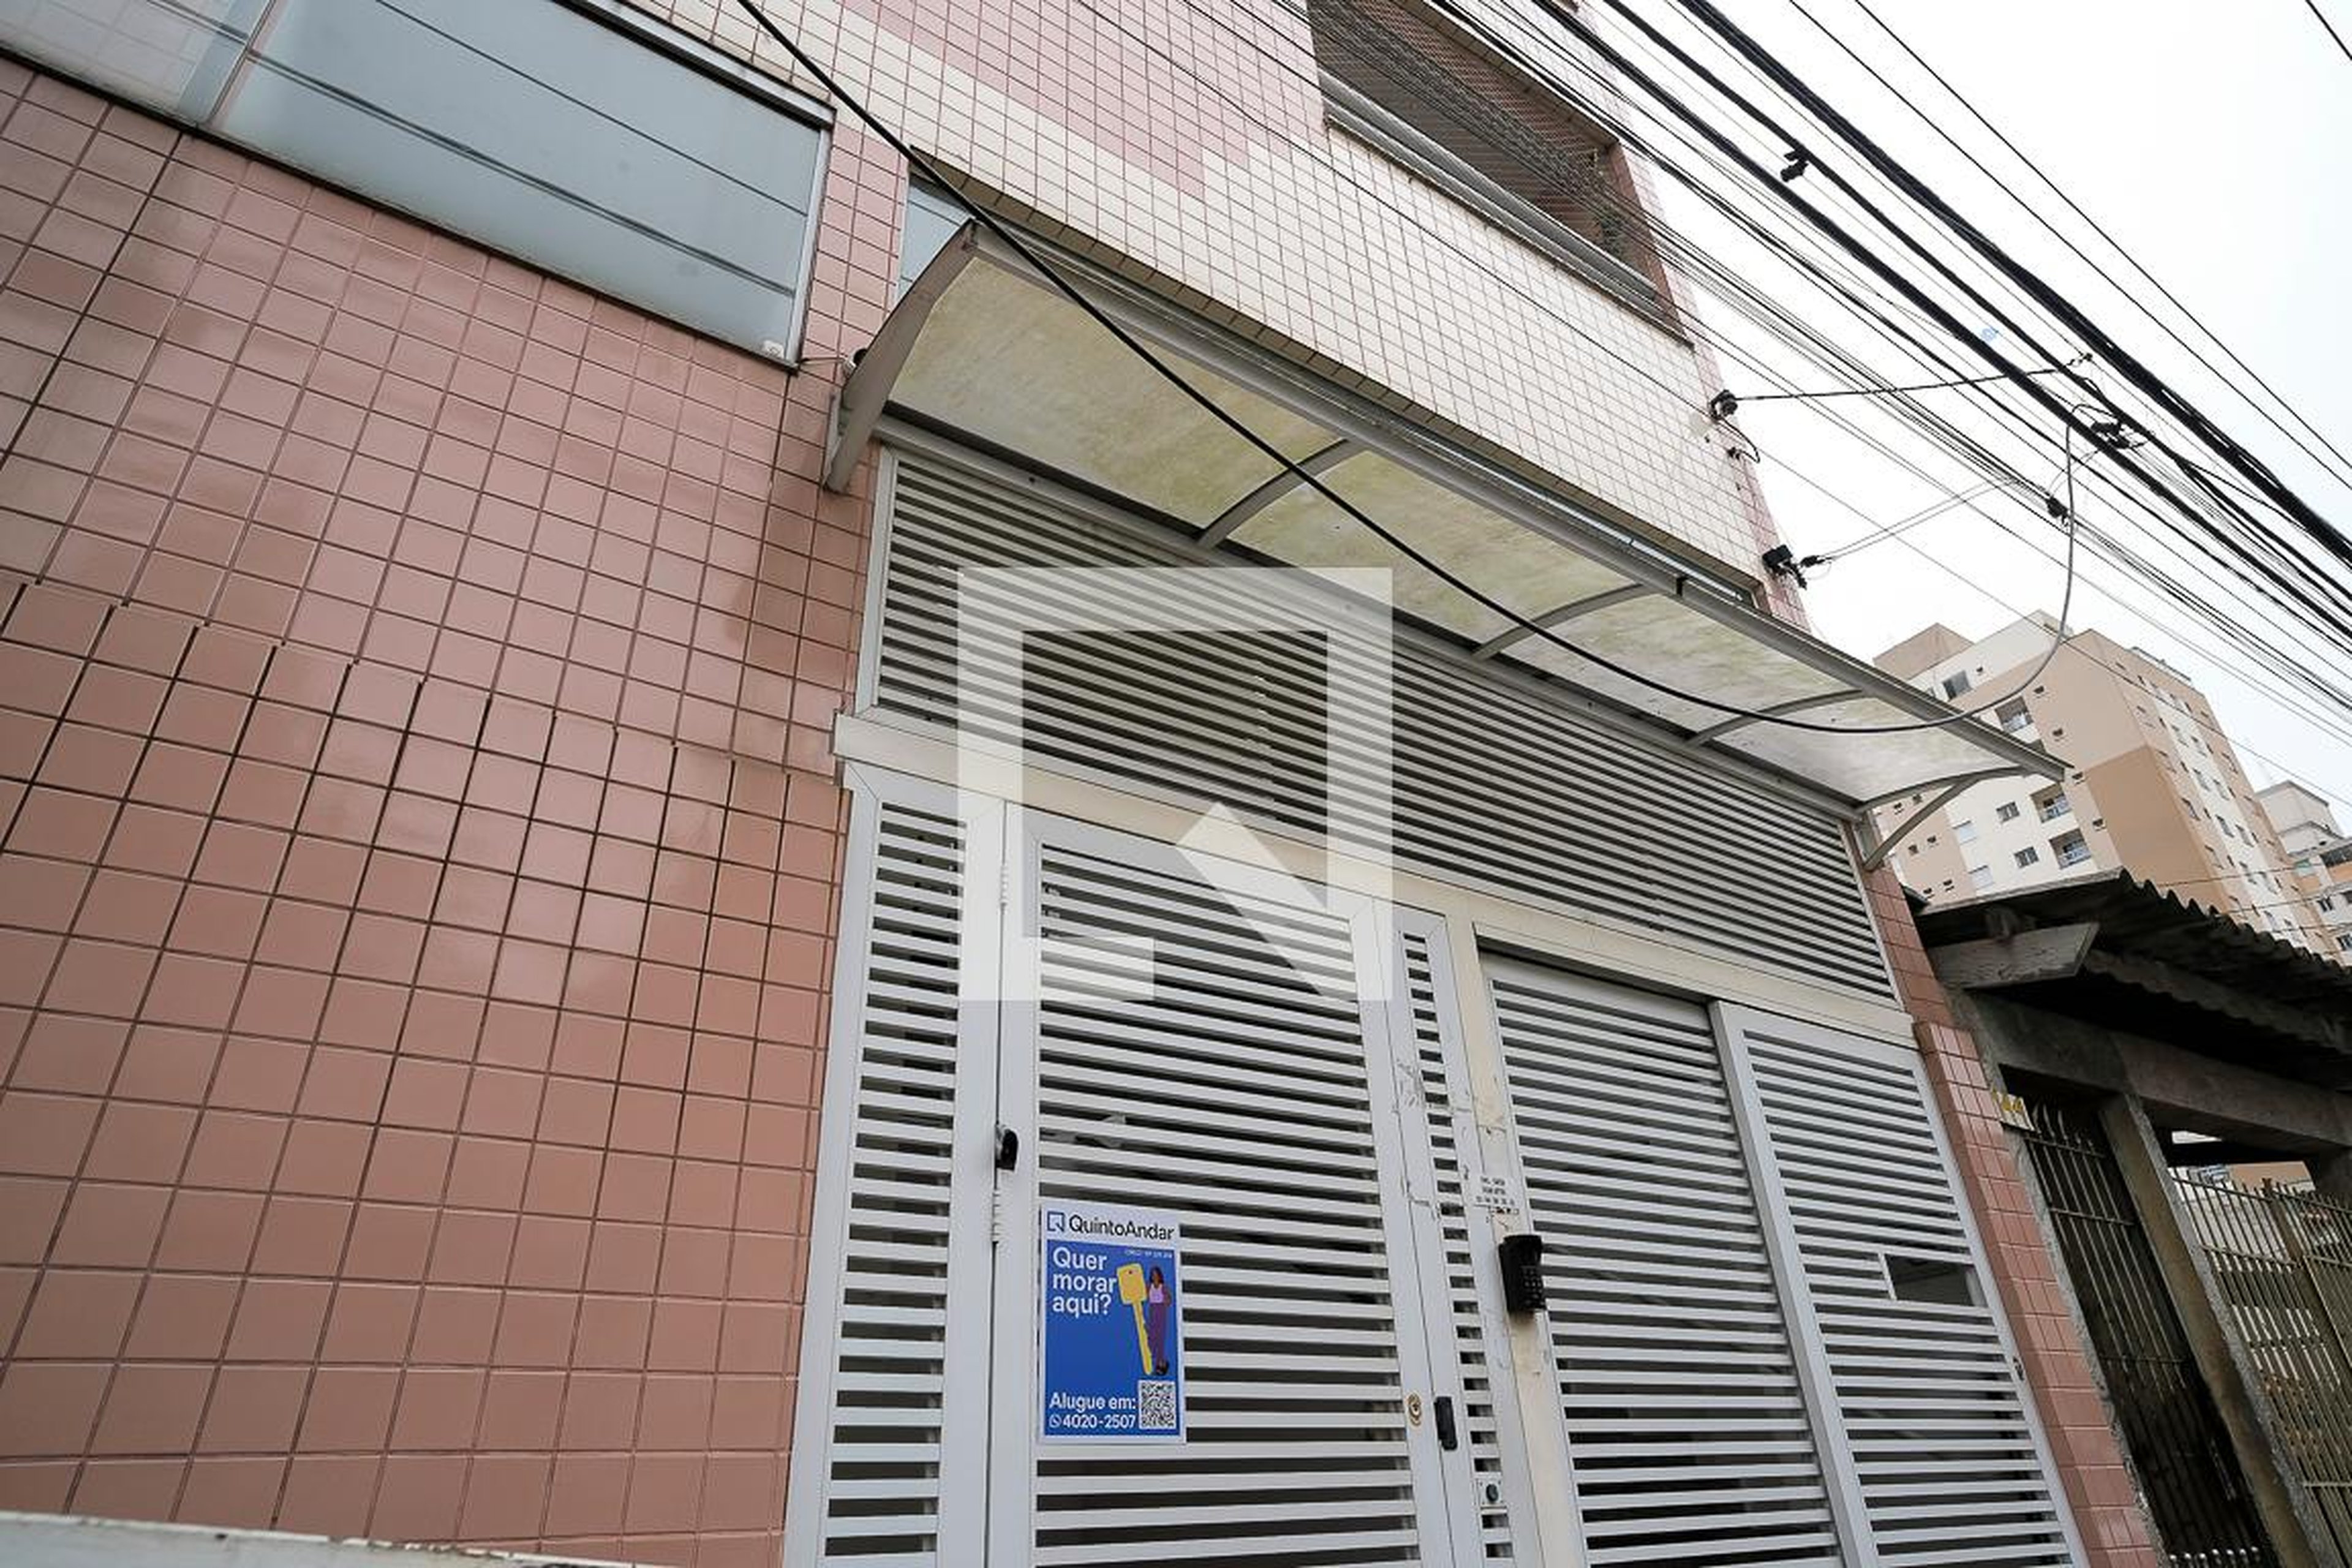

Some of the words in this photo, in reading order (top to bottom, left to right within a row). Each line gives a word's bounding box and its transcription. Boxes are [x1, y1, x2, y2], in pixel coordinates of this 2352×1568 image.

[1069, 1215, 1175, 1240] QuintoAndar
[1052, 1246, 1107, 1270] Quer
[1052, 1273, 1117, 1293] morar
[1052, 1294, 1112, 1318] aqui?
[1049, 1392, 1106, 1414] Alugue
[1108, 1396, 1136, 1409] em:
[1063, 1414, 1136, 1429] 4020-2507
